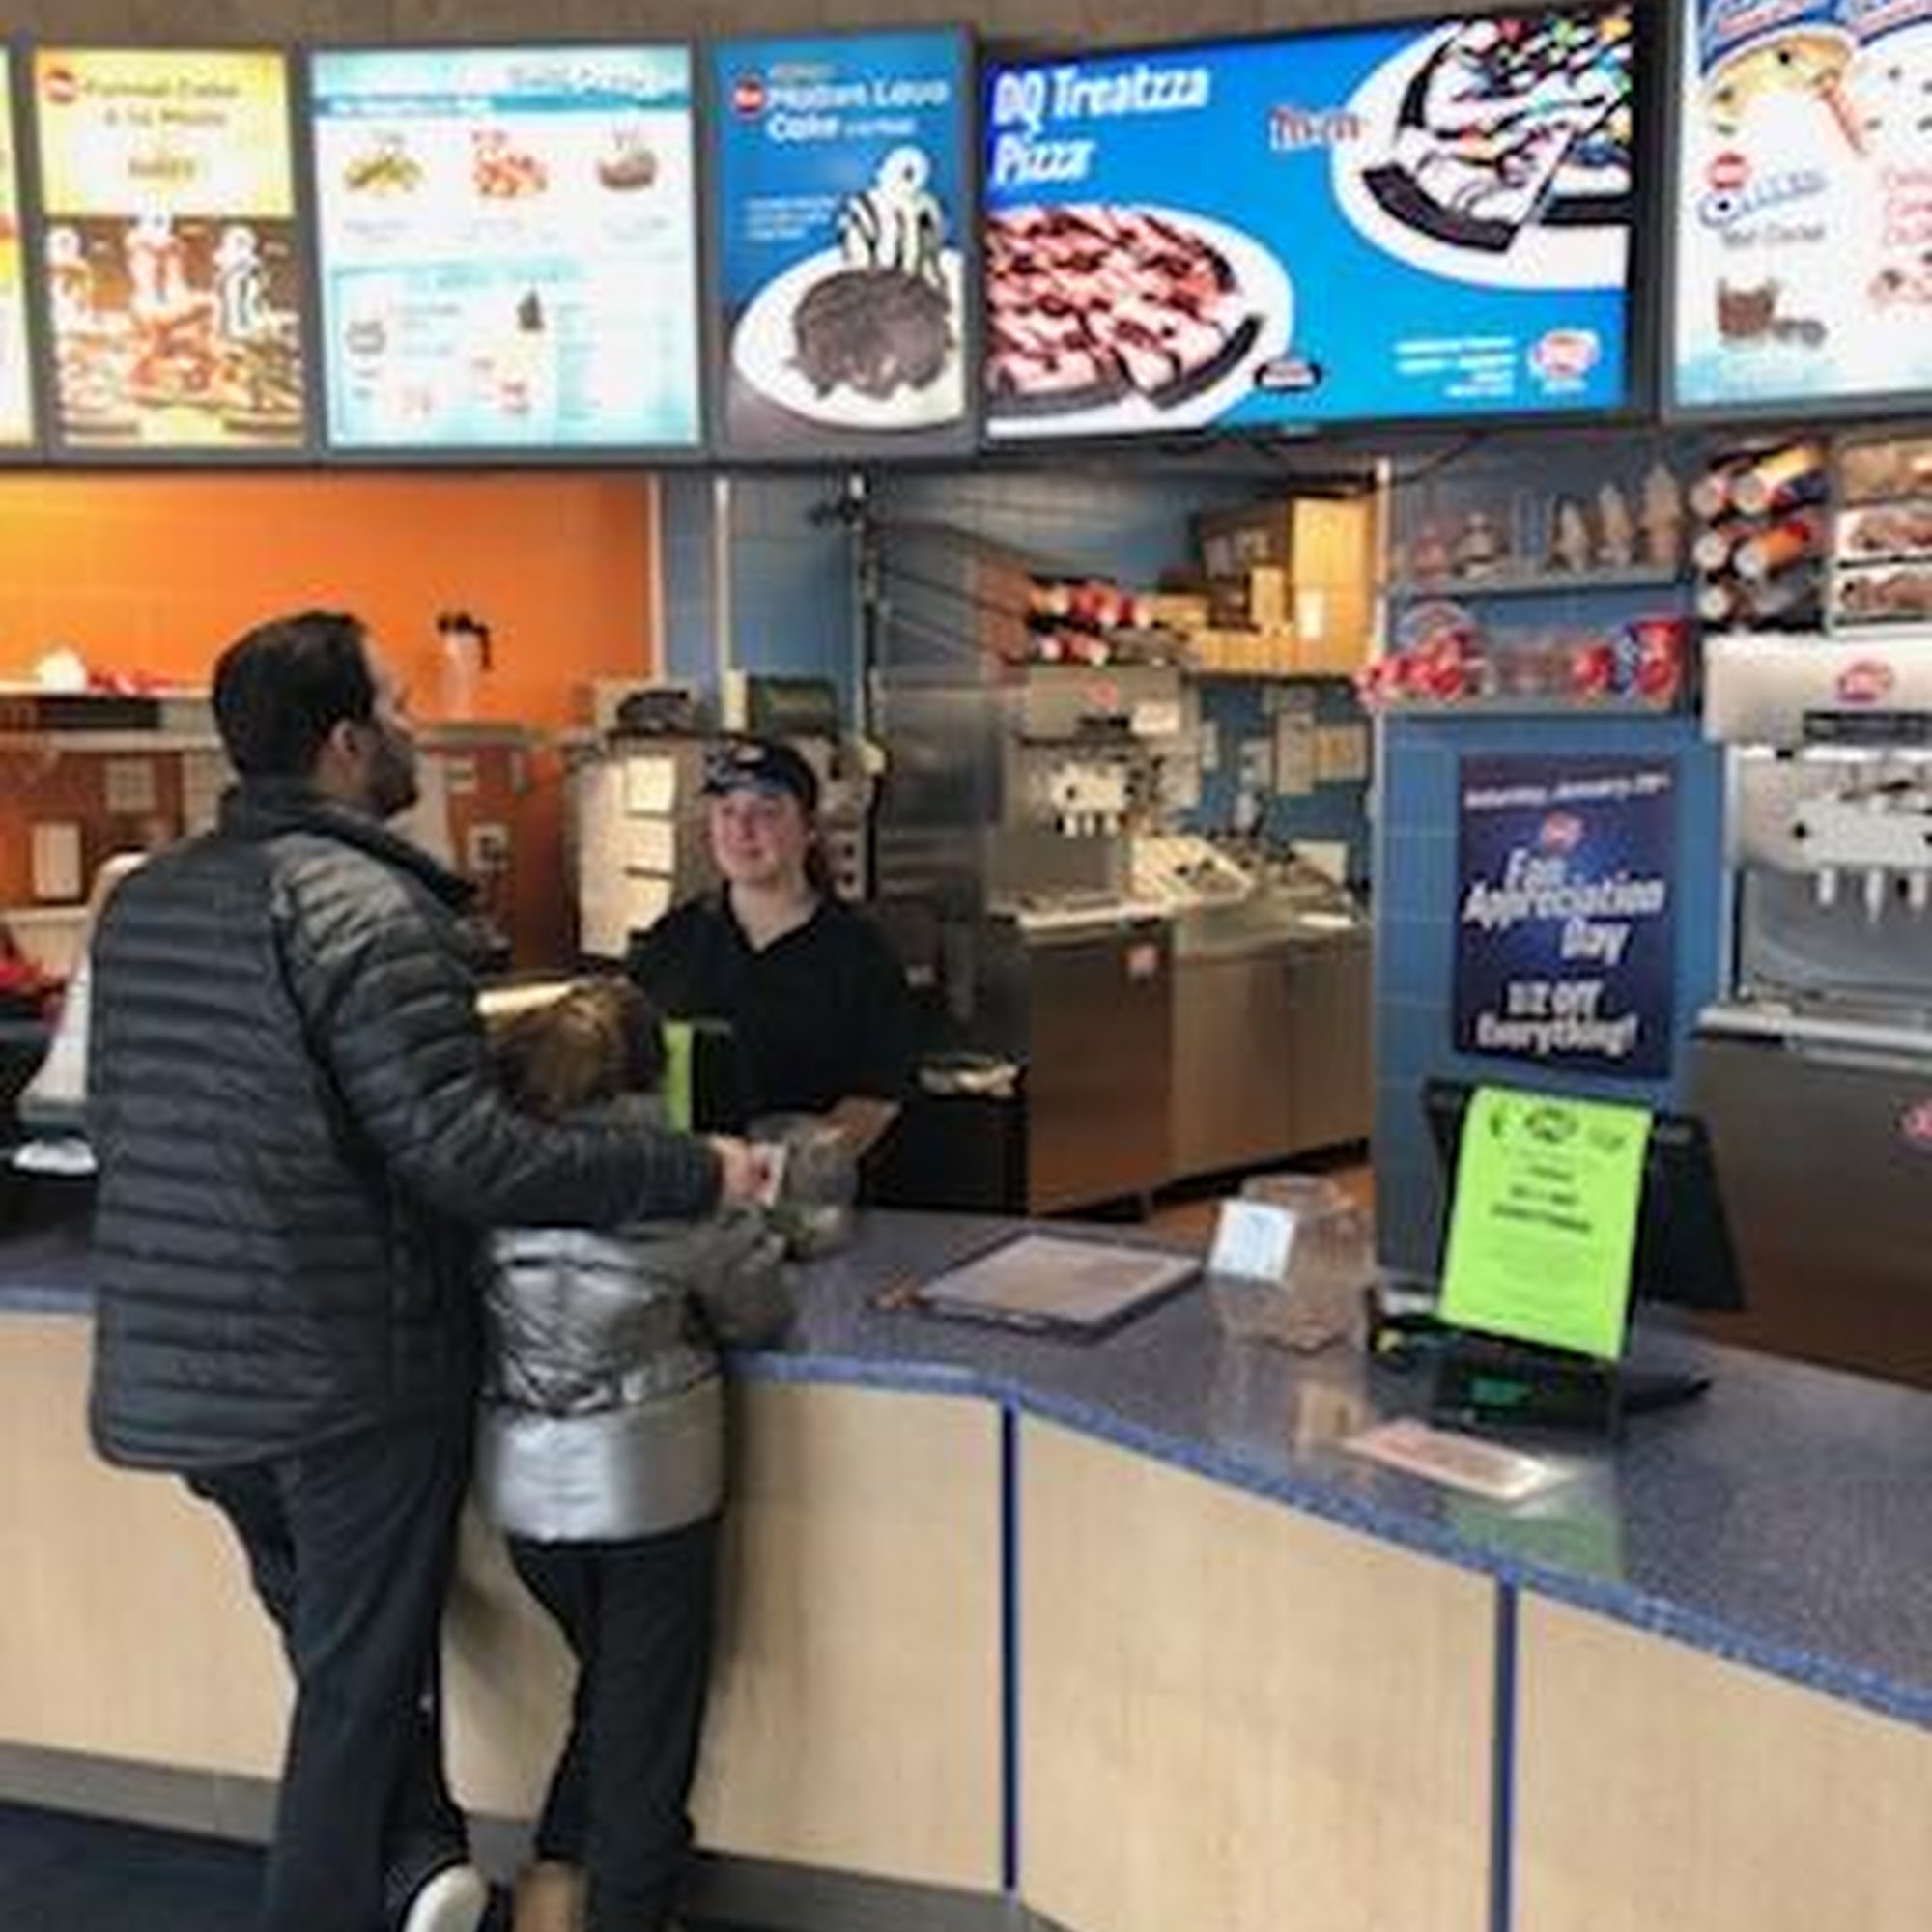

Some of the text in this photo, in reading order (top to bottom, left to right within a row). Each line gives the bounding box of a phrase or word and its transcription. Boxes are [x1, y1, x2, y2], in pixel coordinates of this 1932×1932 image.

[993, 64, 1210, 135] DQ Treatzza
[994, 133, 1097, 185] Pizza
